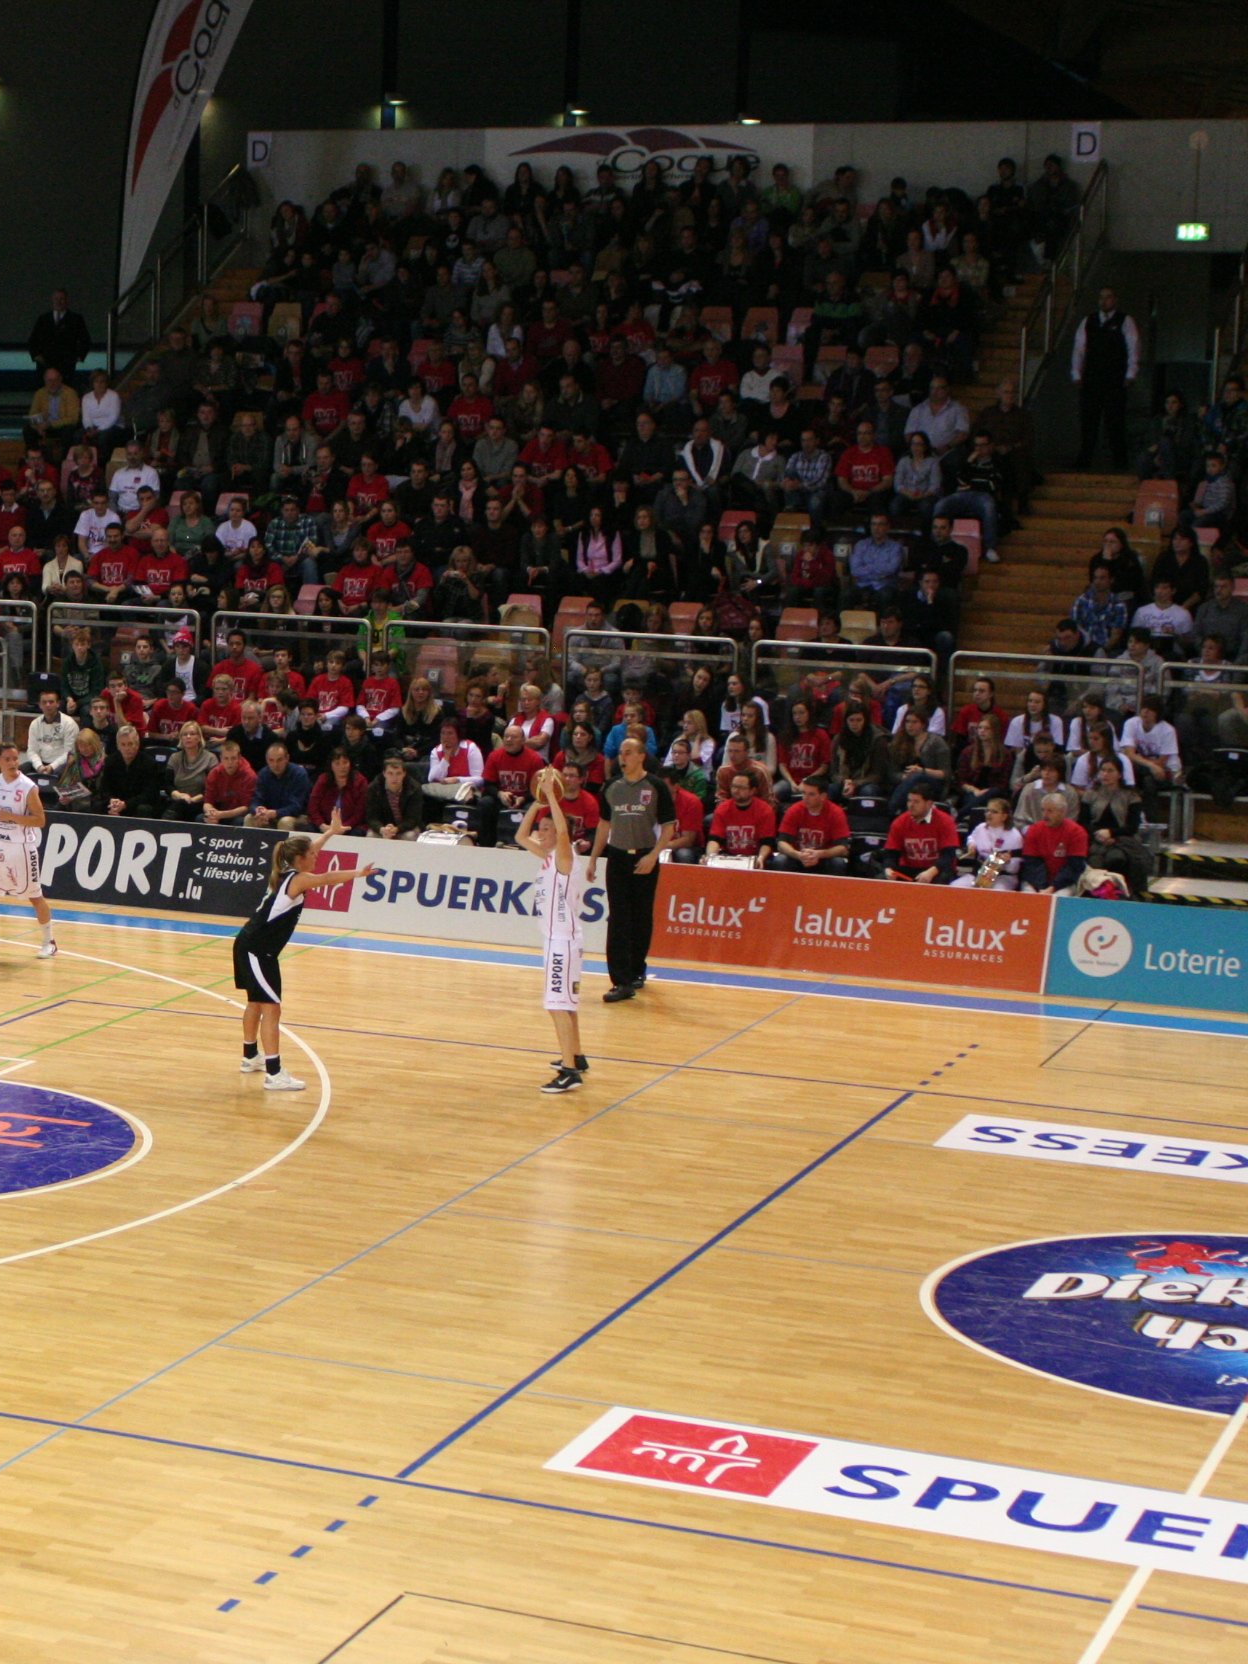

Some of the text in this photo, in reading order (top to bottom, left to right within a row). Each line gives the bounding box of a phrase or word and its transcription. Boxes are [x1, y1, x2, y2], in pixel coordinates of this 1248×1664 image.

[252, 140, 268, 162] D
[1076, 131, 1097, 156] D
[209, 838, 244, 850] sport
[27, 849, 39, 884] ASPORT
[206, 851, 254, 866] fashion
[203, 866, 254, 883] lifestyle
[178, 877, 203, 900] .lu
[667, 894, 743, 928] lalux
[666, 925, 742, 940] ASSURANCES
[794, 906, 873, 940] lalux
[924, 917, 1006, 951] lalux
[792, 937, 870, 951] ASSURANCES
[923, 949, 1003, 963] ASSURANCES
[1144, 943, 1241, 977] Loterie
[551, 952, 564, 994] ASPORT
